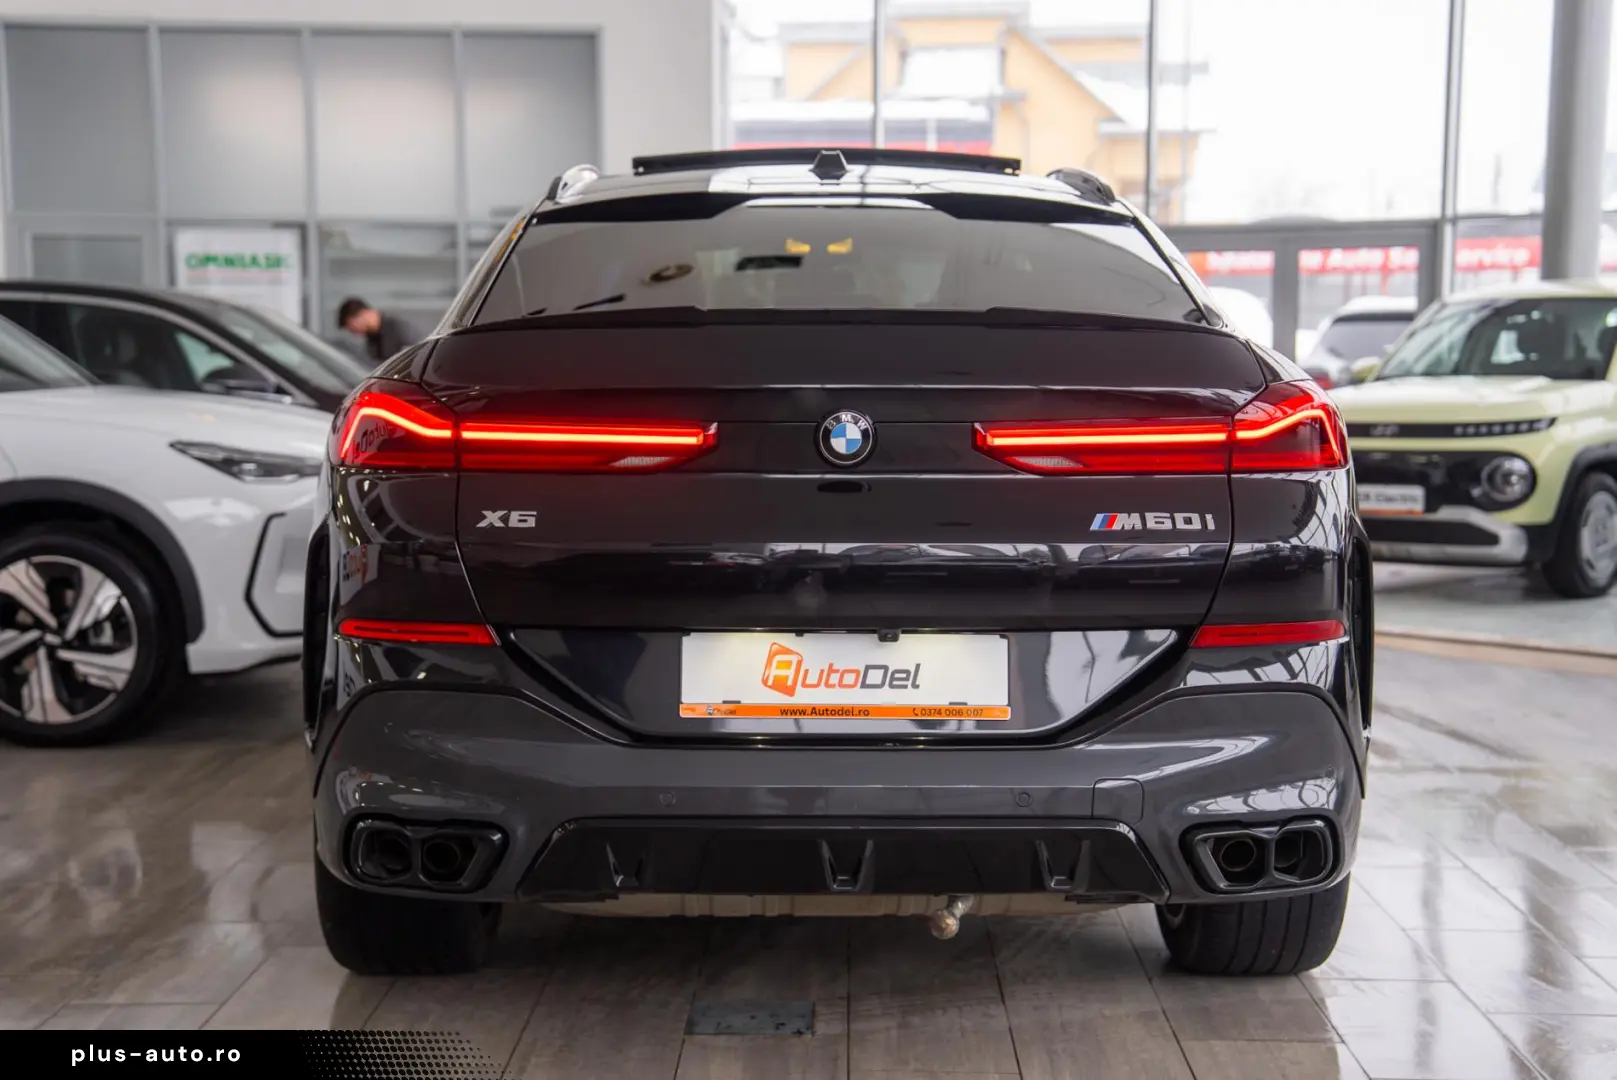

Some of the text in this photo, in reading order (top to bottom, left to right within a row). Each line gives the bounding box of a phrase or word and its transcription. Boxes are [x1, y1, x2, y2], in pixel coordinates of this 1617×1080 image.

[826, 414, 867, 430] BMW
[475, 510, 537, 528] X6
[764, 650, 921, 691] AutoDel
[780, 706, 870, 717] www.Autodel.ro
[920, 707, 984, 717] 0374 006 007
